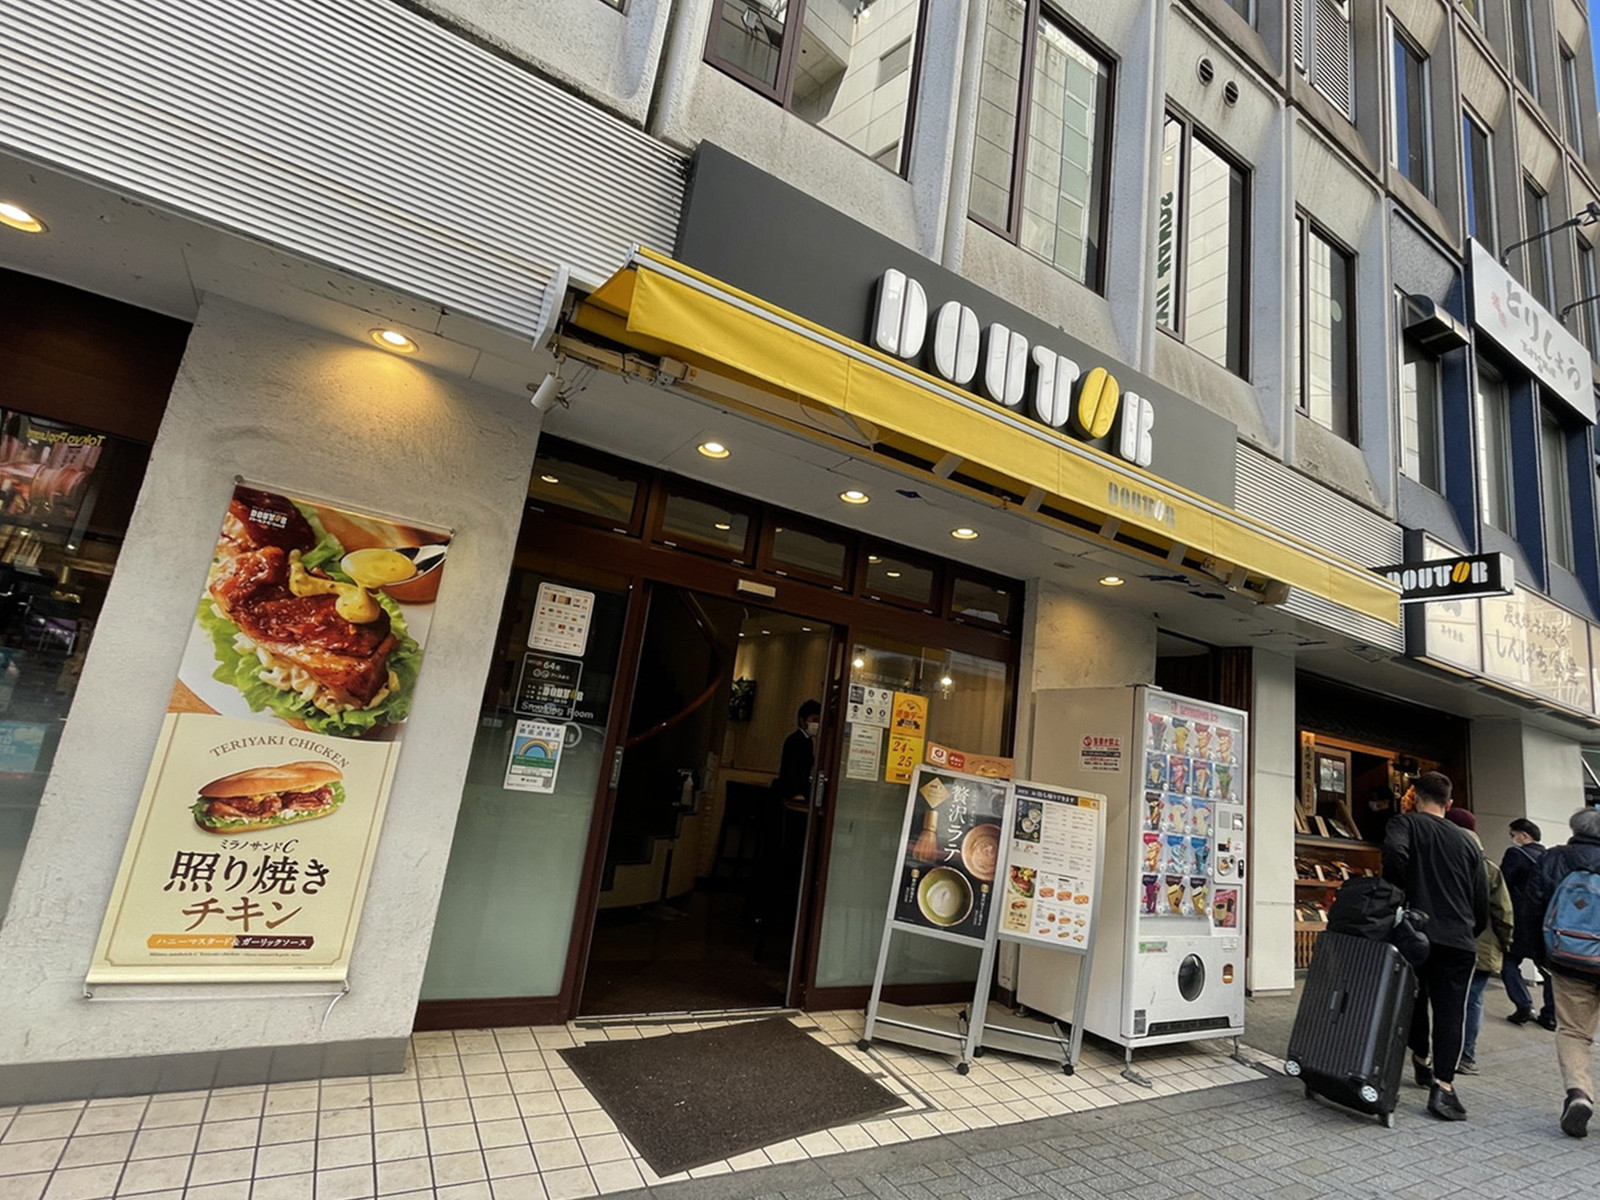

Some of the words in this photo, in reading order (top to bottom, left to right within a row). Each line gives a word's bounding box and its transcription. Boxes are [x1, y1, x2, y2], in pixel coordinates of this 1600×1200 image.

[1506, 279, 1581, 391] とりしょう
[875, 267, 1155, 468] DOUTOR
[1108, 481, 1176, 530] DOUTOR
[209, 735, 288, 757] TERIYAKI
[288, 737, 350, 768] CHICKEN
[897, 755, 913, 768] 25
[944, 784, 970, 862] 贅沢ラテ
[163, 850, 330, 895] 照り焼き
[182, 896, 302, 933] チキン
